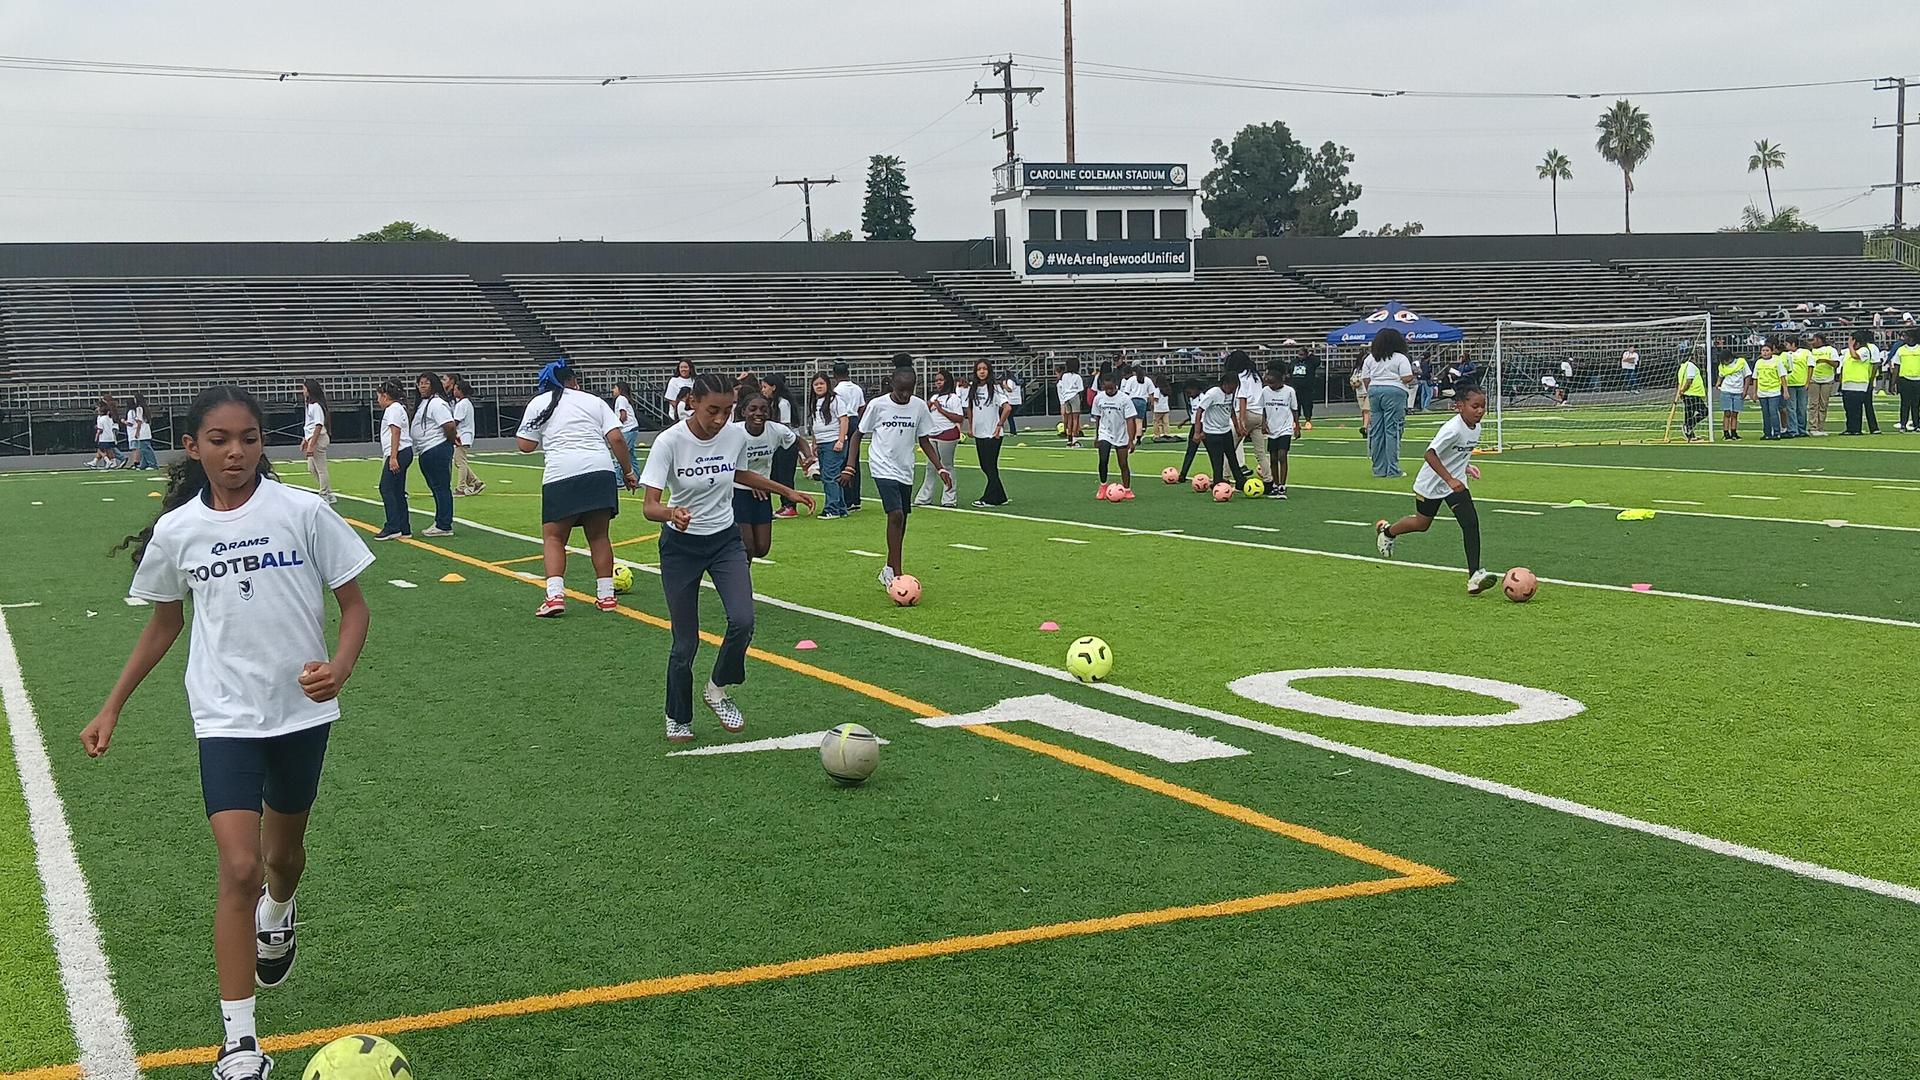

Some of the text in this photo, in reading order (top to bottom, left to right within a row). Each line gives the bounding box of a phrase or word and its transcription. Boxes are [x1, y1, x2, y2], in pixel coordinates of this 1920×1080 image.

[1029, 169, 1166, 180] CAROLINE COLEMAN STADIUM
[1046, 252, 1185, 267] #WeAreInglewoodUnified
[746, 448, 776, 459] OTBAL
[228, 536, 270, 550] RAMS
